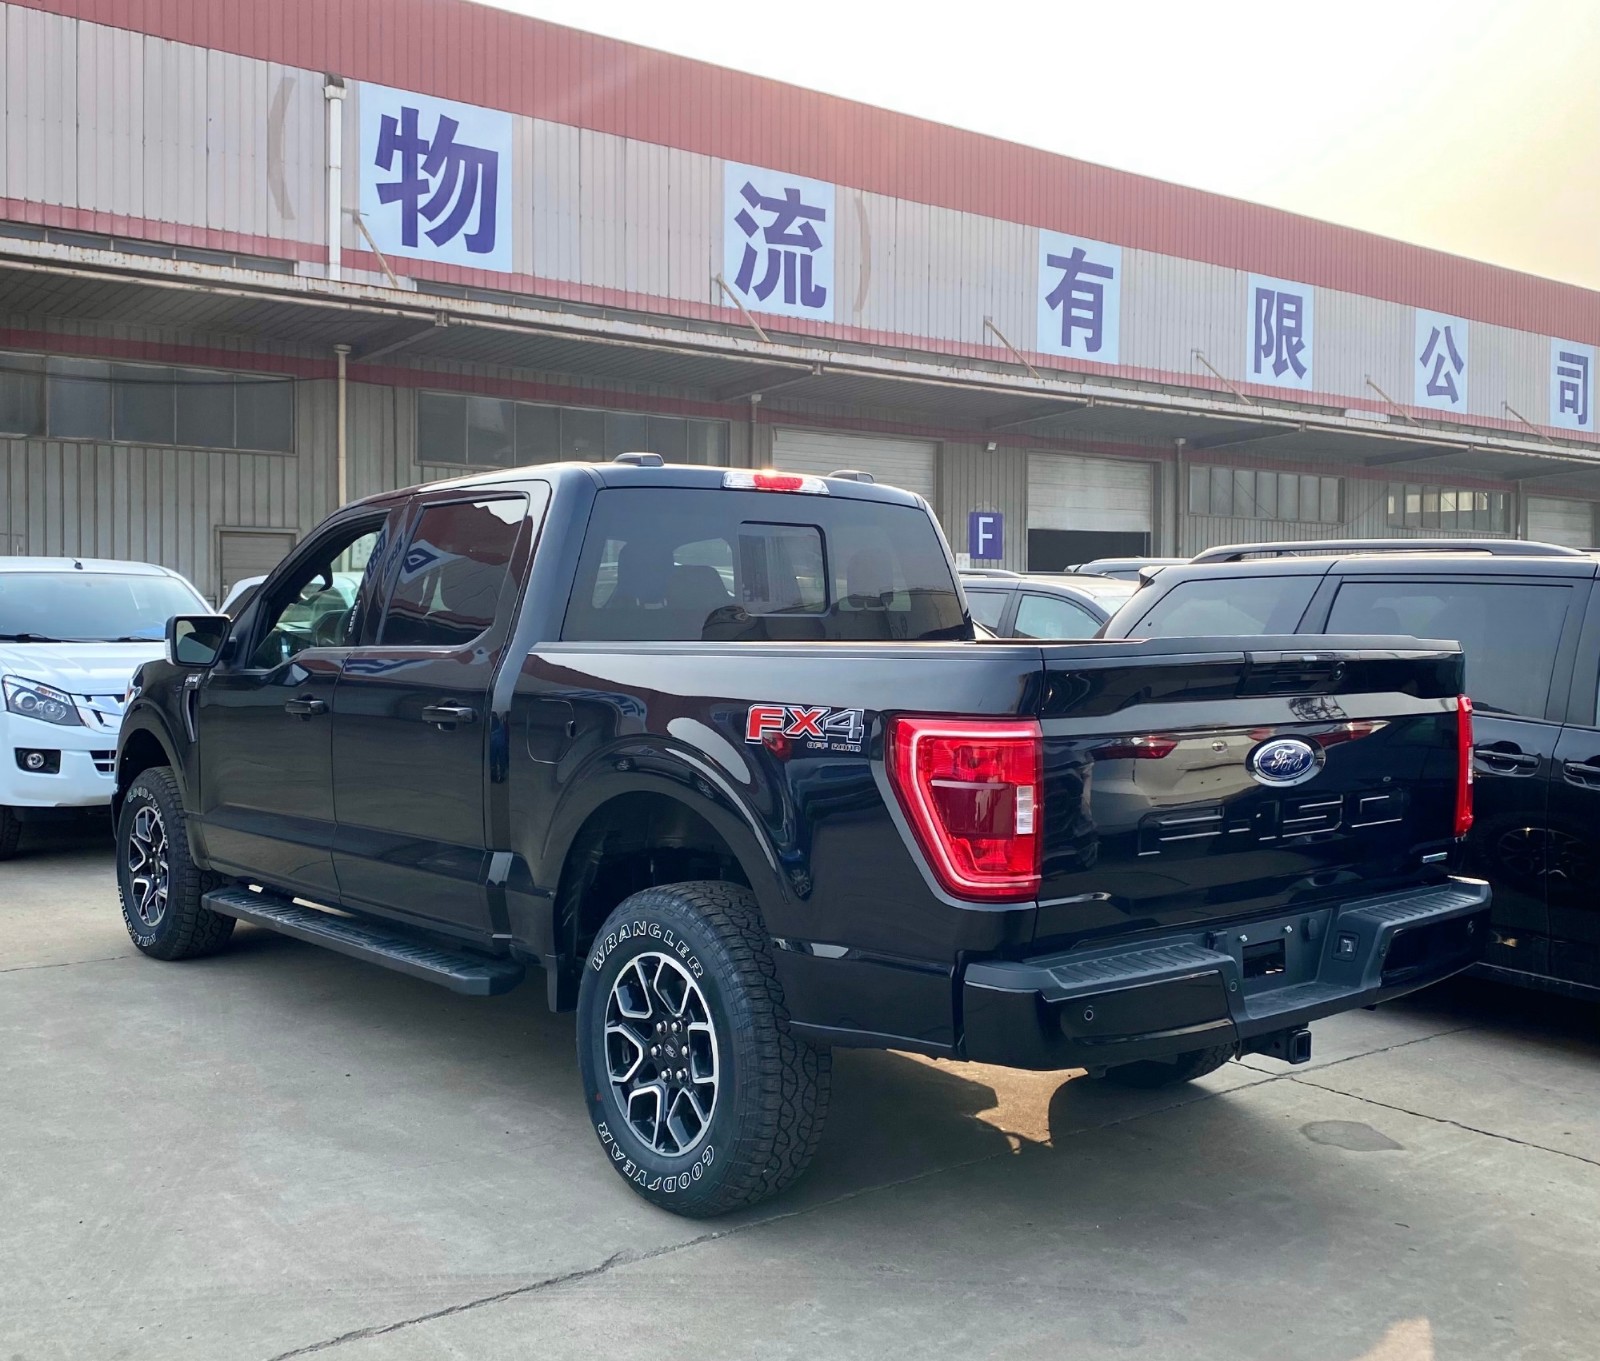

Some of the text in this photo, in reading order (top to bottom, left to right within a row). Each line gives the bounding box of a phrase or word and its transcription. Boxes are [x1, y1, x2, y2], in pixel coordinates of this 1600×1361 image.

[978, 517, 994, 555] F
[745, 704, 865, 744] FX4
[806, 742, 828, 750] OFF
[1270, 748, 1304, 772] Ford
[1137, 786, 1403, 856] F-150
[592, 921, 704, 978] WRANGLER
[598, 1122, 714, 1193] GOODYEAR
